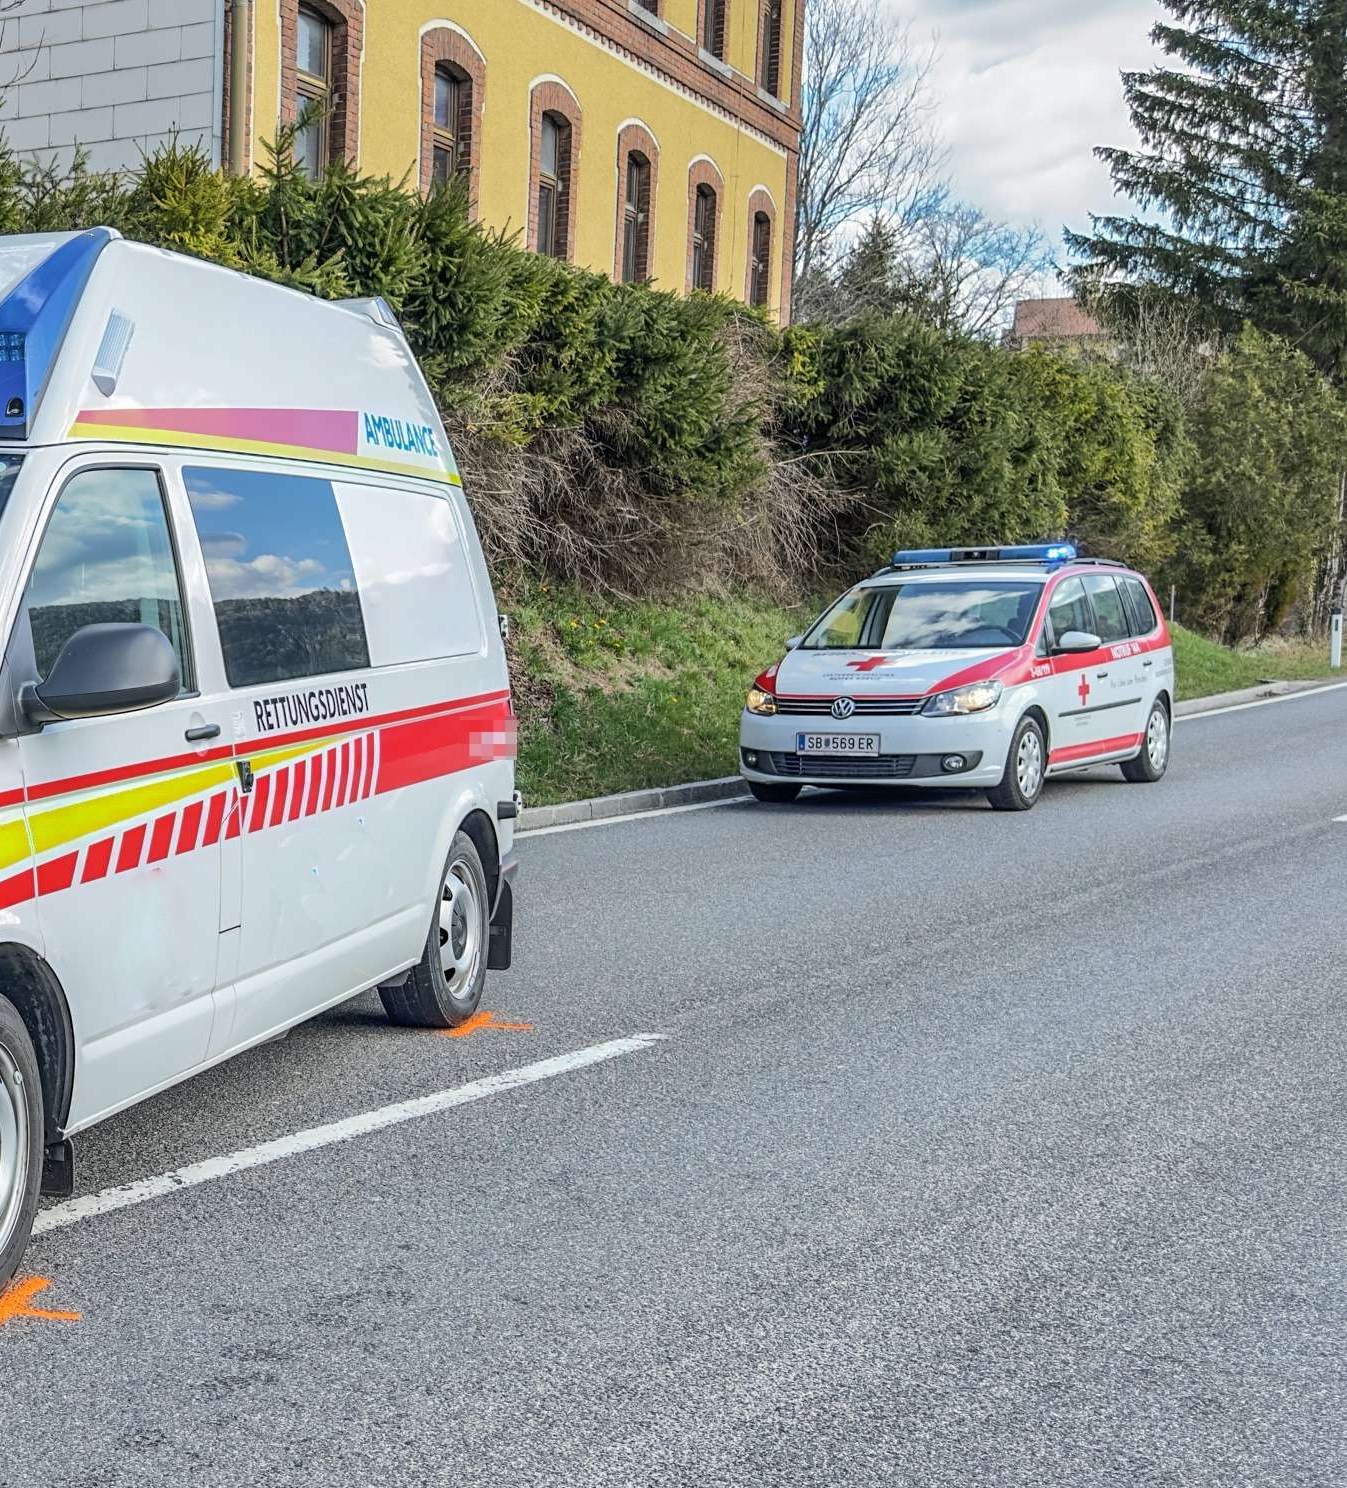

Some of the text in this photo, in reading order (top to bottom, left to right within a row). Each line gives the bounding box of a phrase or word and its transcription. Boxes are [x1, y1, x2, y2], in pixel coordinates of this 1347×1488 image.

[364, 412, 439, 457] AMBULANCE
[253, 683, 369, 732] RETTUNGSDIENST
[807, 736, 874, 750] SB 569 ER
